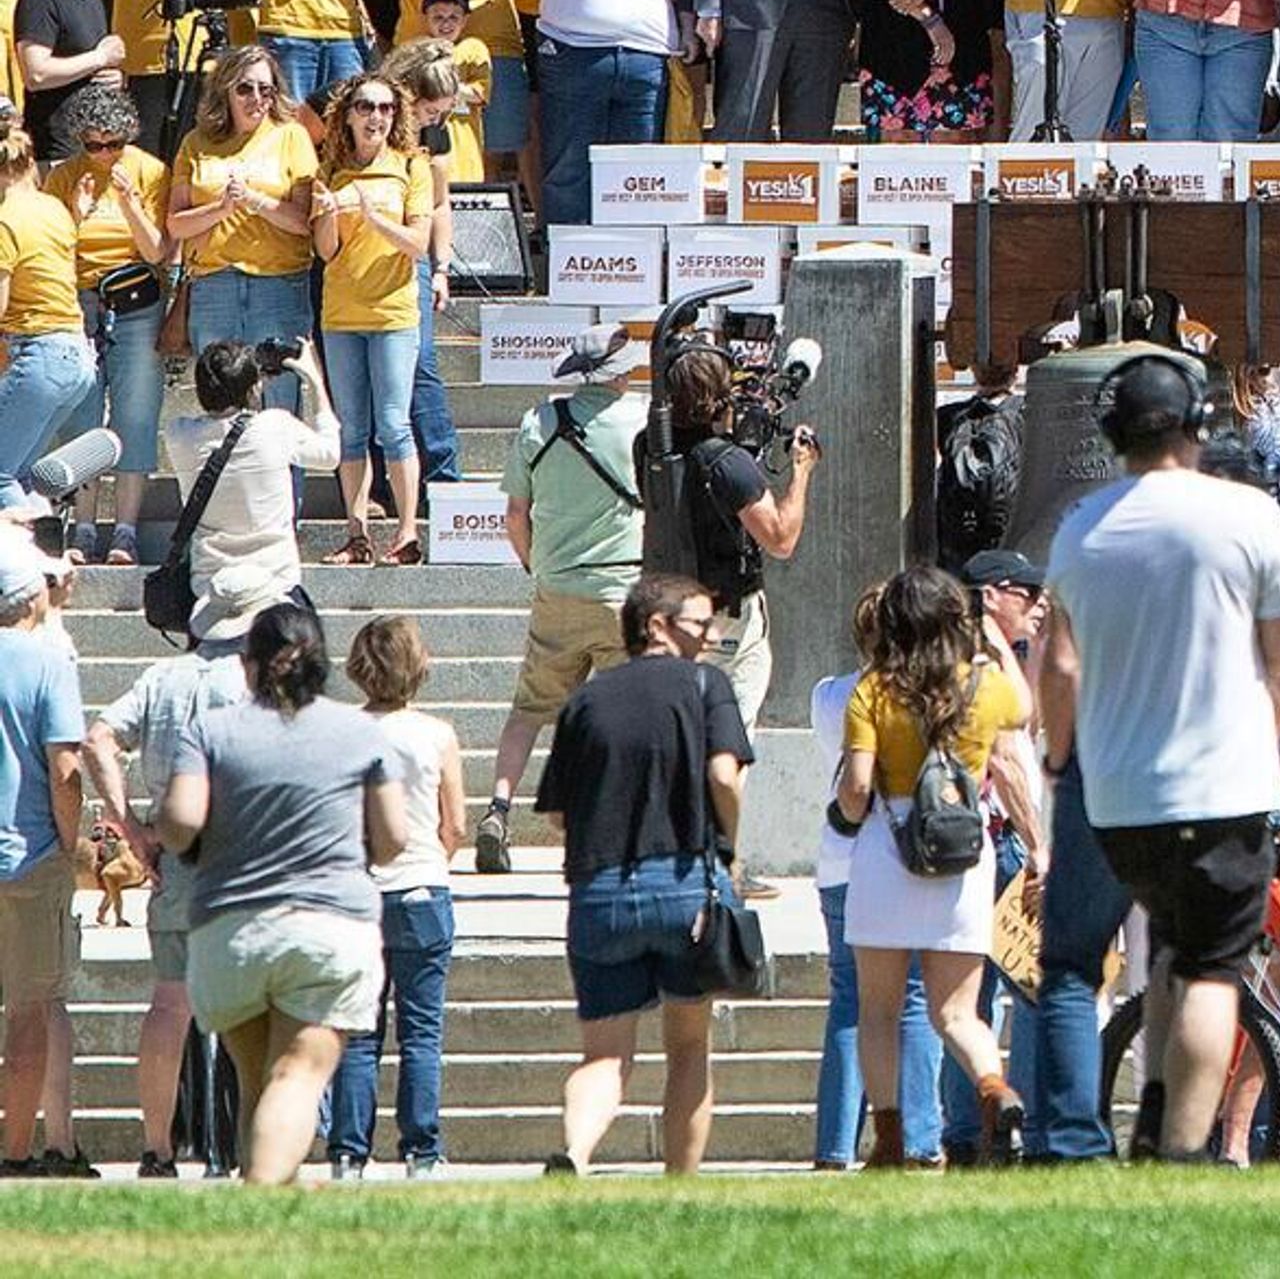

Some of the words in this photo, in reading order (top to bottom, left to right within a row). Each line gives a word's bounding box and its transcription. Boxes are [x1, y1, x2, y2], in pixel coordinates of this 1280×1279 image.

[623, 175, 666, 192] GEM
[746, 180, 789, 200] YES!
[873, 175, 949, 192] BLAINE
[564, 256, 638, 272] ADAMS
[676, 255, 767, 268] JEFFERSON
